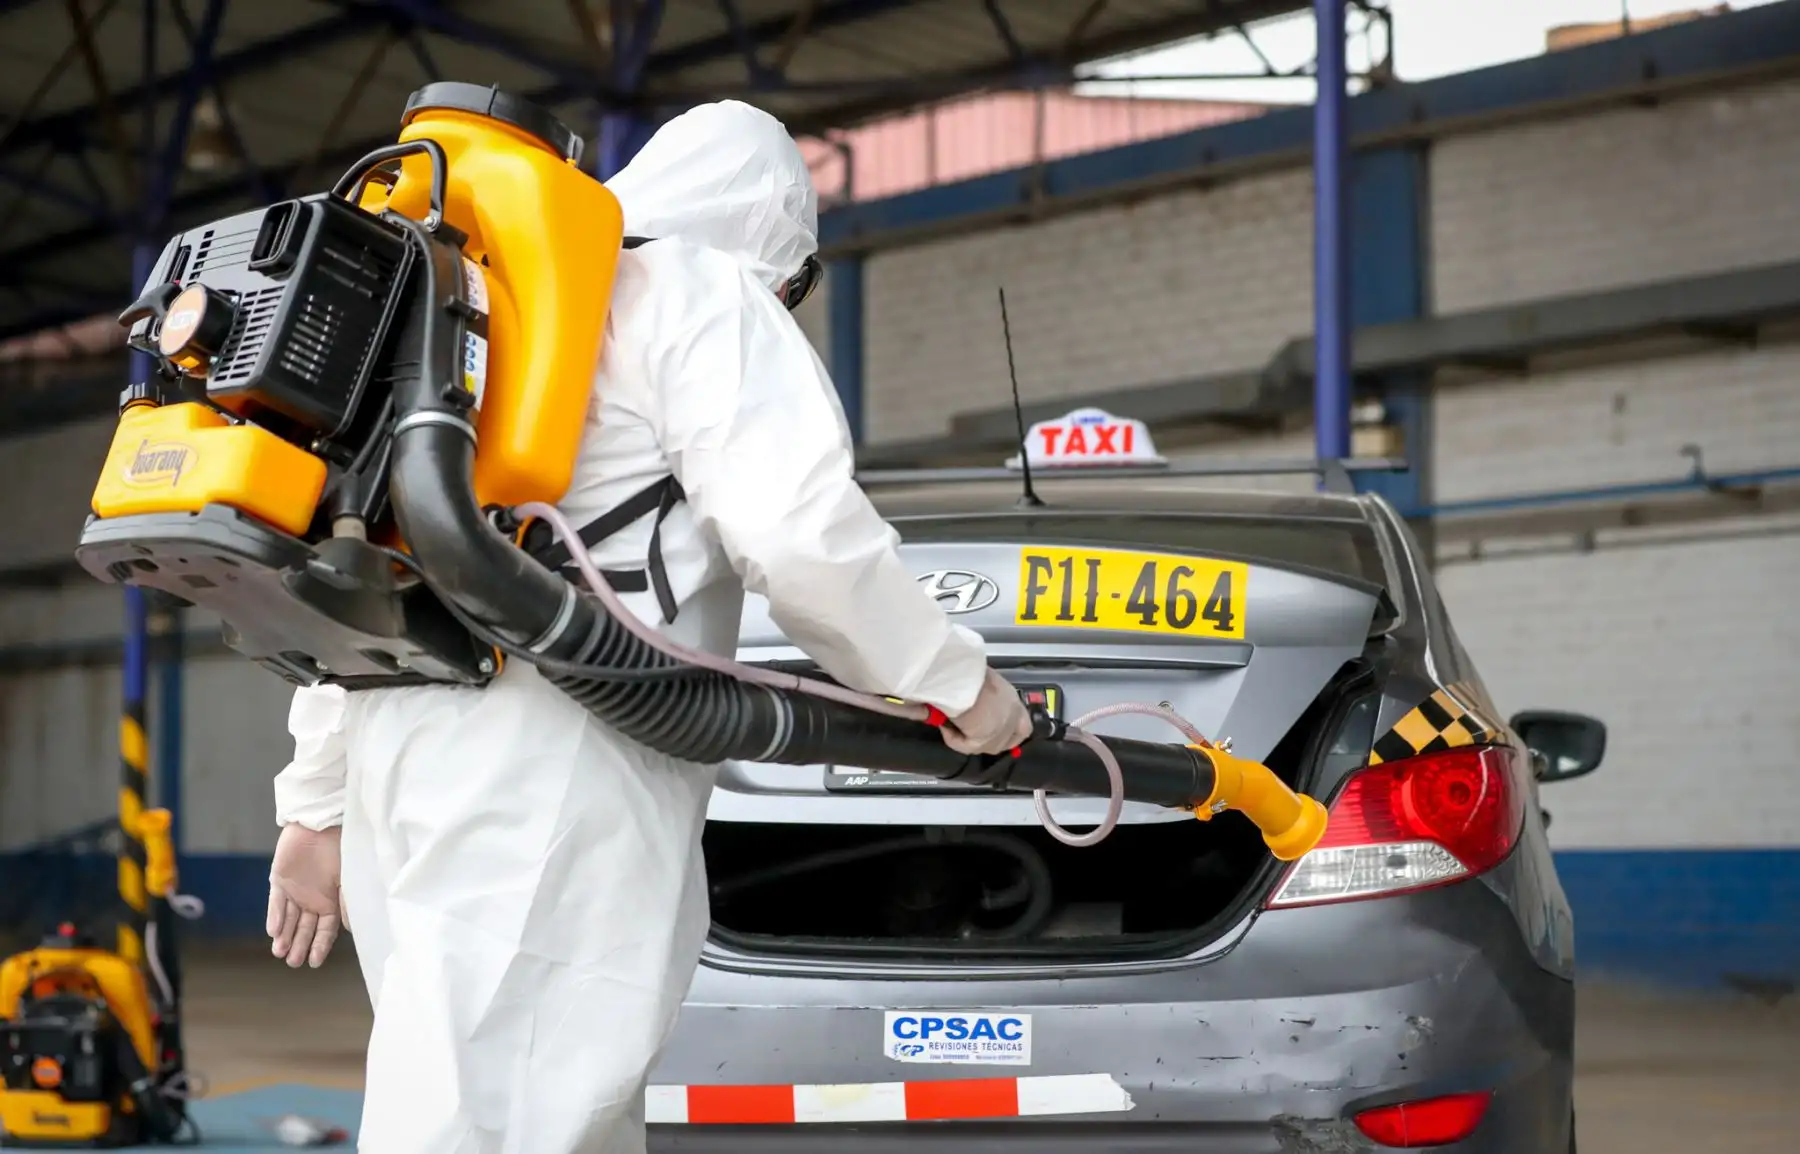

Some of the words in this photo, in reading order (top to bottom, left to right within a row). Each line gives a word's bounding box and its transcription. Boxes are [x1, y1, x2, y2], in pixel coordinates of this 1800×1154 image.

[1040, 425, 1133, 456] TAXI
[1020, 556, 1235, 632] F1I-464
[845, 776, 869, 786] AAP
[893, 1017, 1023, 1040] CPSAC
[929, 1041, 978, 1051] REVISIONES
[982, 1041, 1023, 1051] TÉCNICAS
